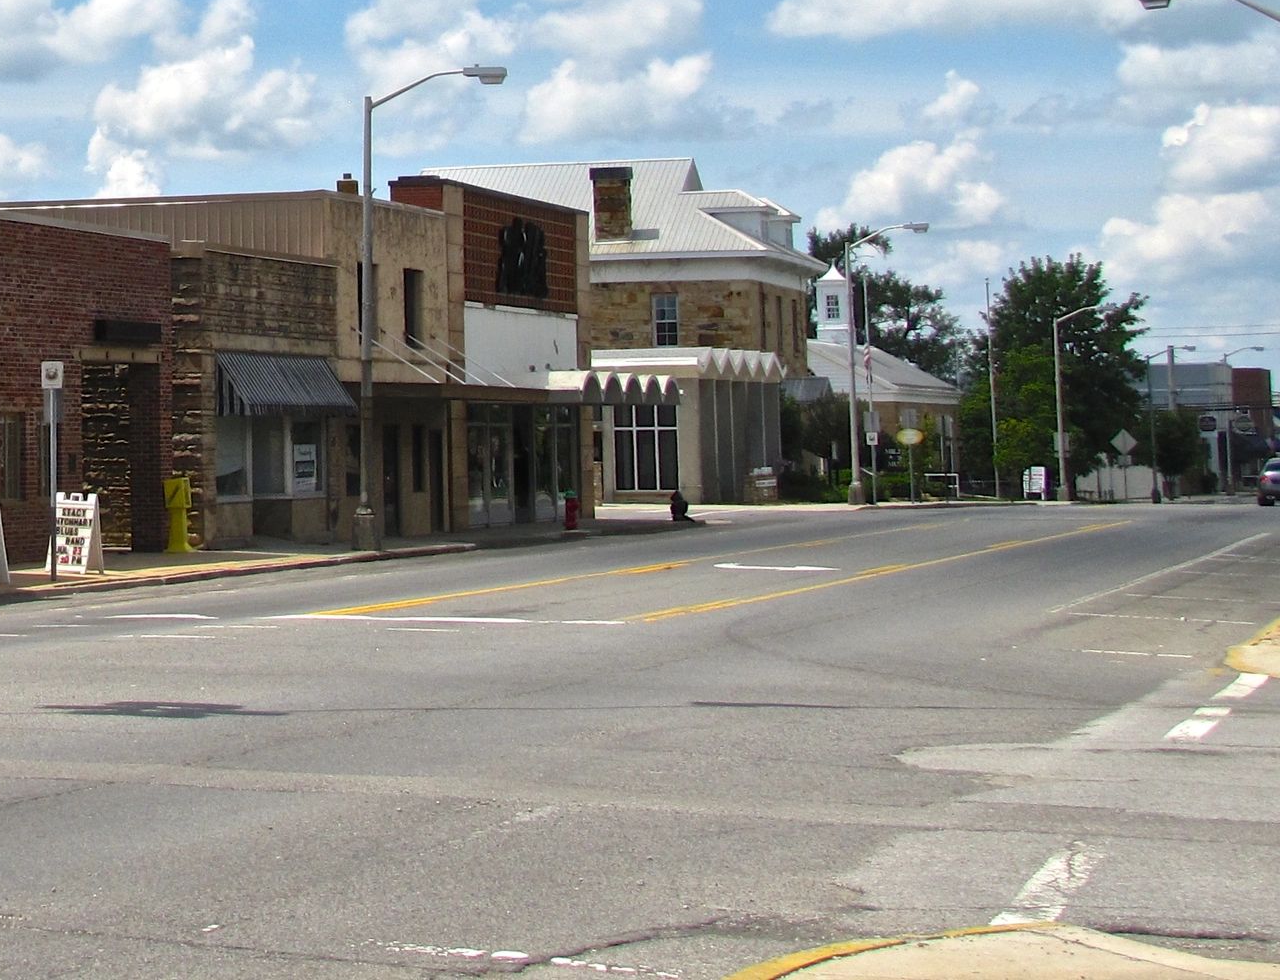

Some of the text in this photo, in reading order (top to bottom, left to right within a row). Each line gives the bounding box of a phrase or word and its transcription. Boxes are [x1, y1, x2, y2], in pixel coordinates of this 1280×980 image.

[62, 508, 86, 516] STACY
[56, 518, 92, 526] ITCHHART
[56, 527, 78, 535] BLUES
[65, 537, 85, 545] BAND
